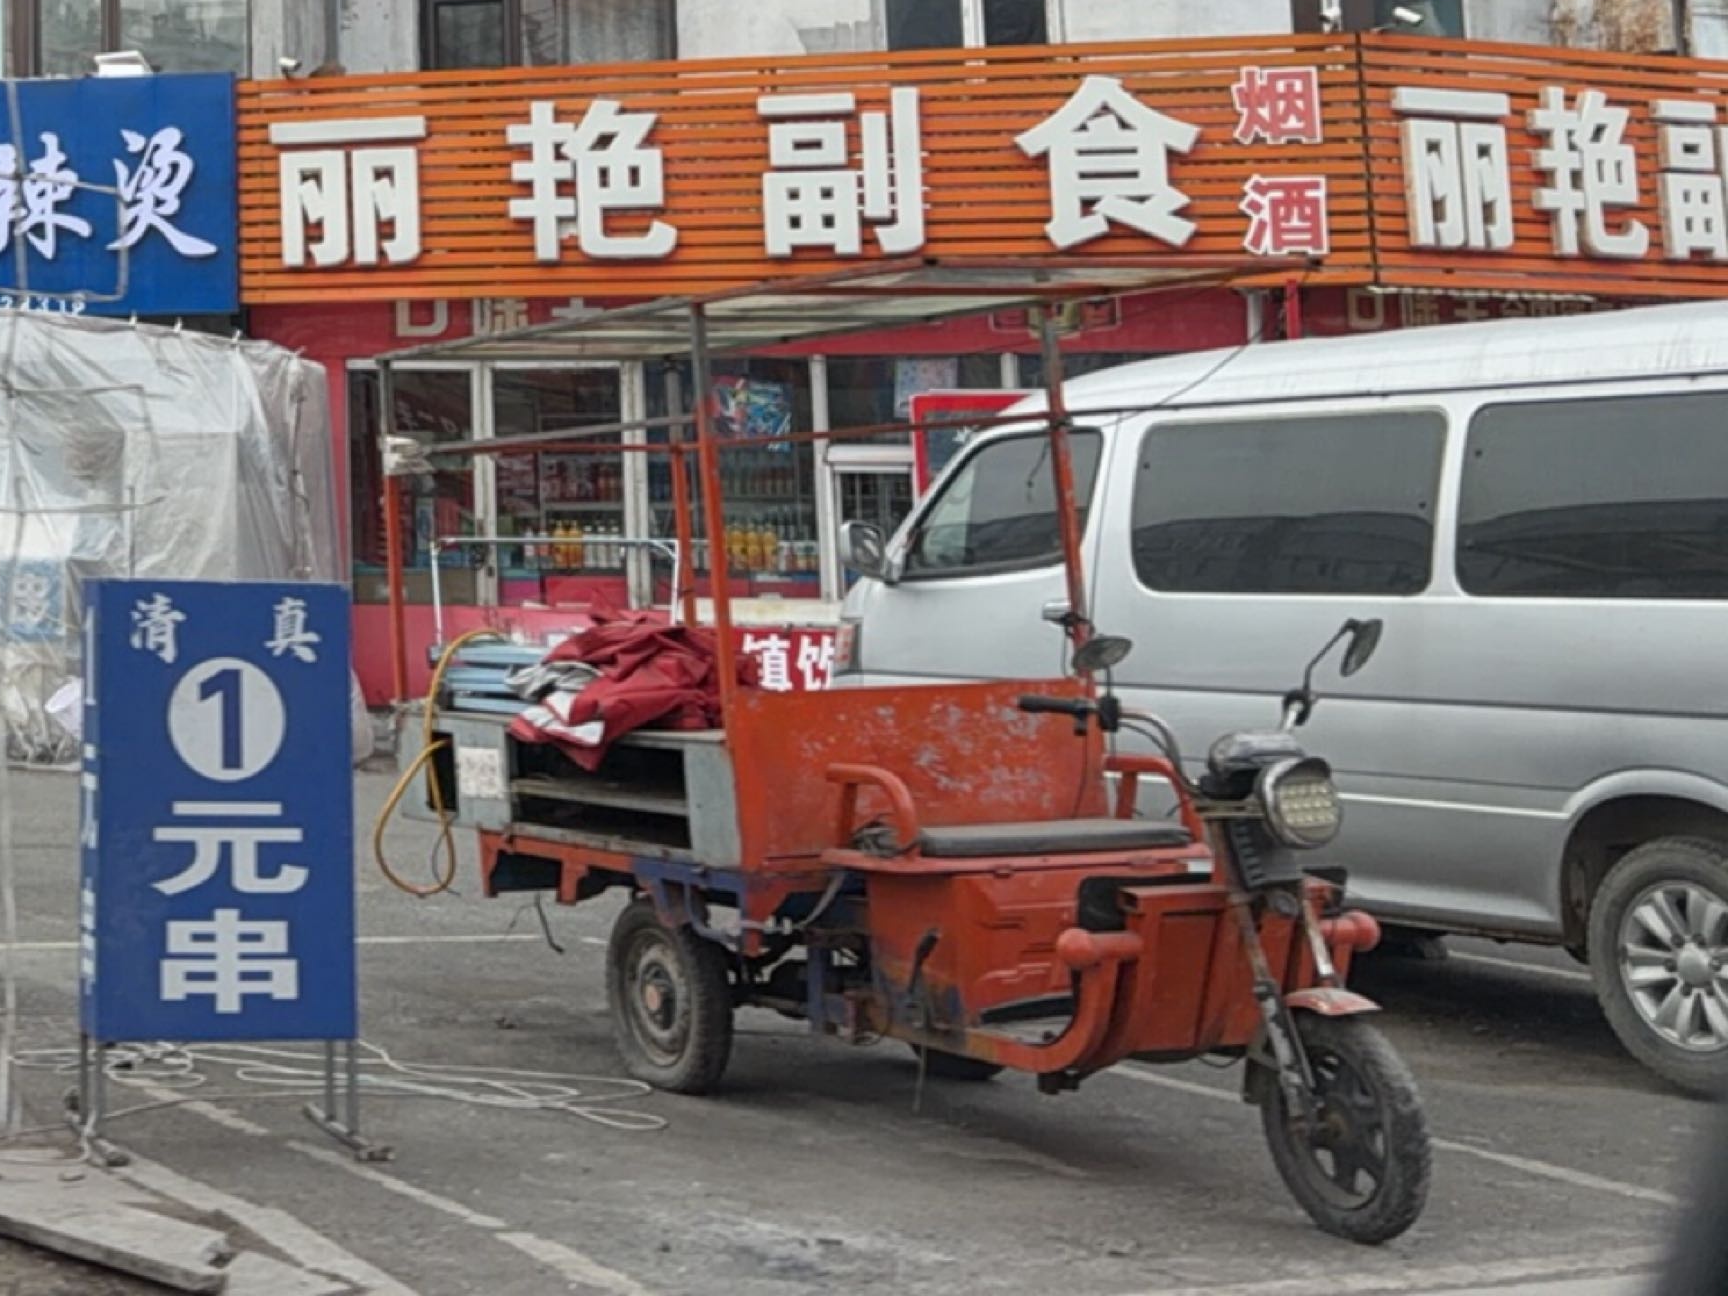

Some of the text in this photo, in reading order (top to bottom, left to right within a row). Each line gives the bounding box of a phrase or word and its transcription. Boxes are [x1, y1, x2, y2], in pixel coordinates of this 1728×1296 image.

[270, 76, 1201, 266] 丽艳副食
[1232, 66, 1330, 256] 烟酒
[1393, 86, 1728, 260] 丽艳副
[130, 593, 322, 664] 清真
